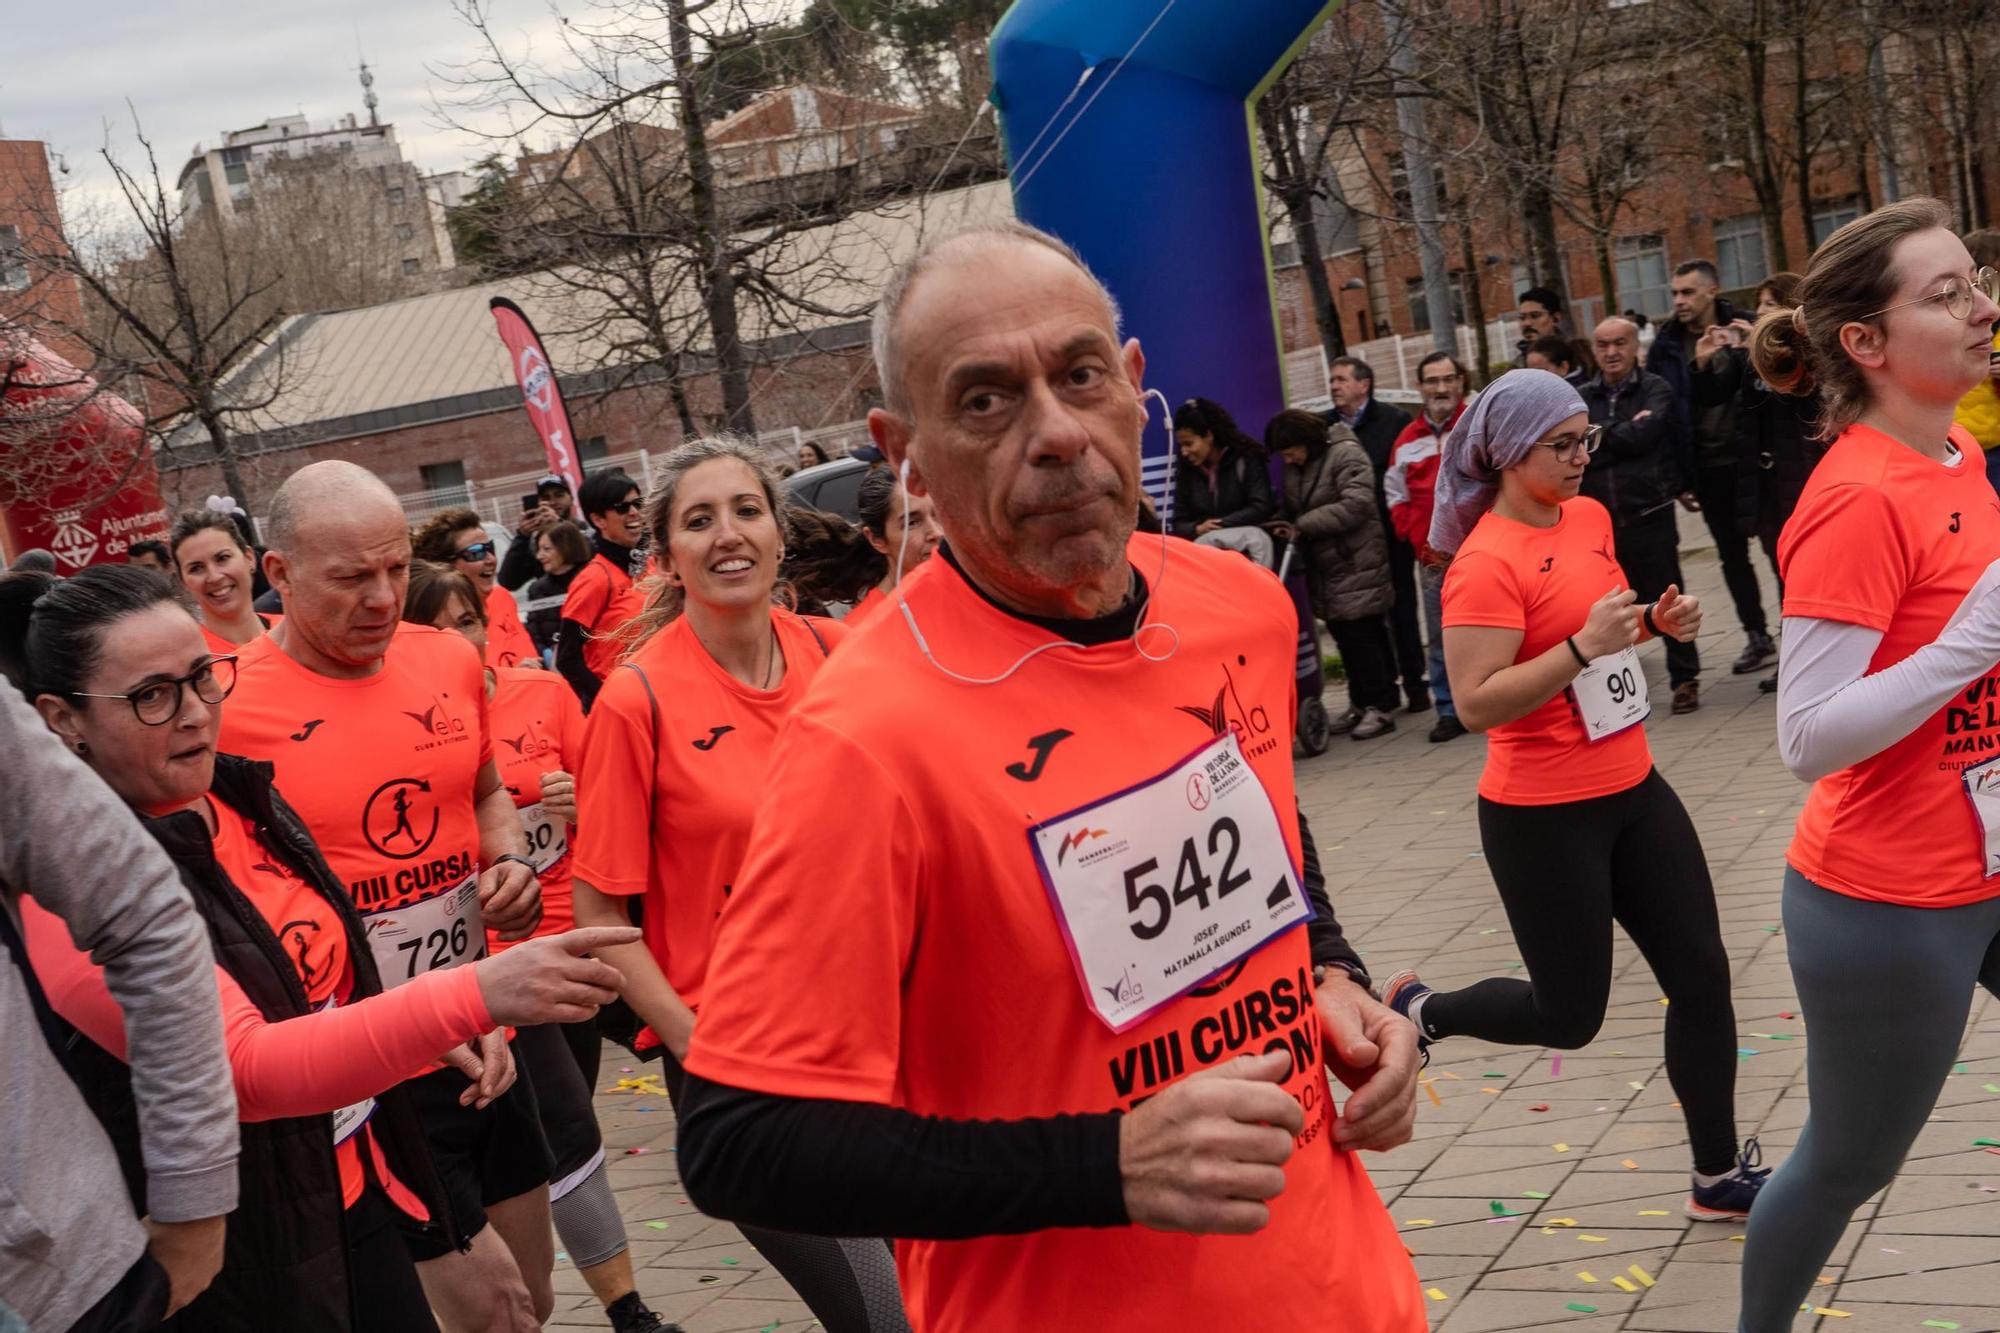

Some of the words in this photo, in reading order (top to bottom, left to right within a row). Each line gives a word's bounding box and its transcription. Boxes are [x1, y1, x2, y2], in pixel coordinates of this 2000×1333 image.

[105, 538, 128, 555] de
[1607, 667, 1636, 704] 90
[1985, 701, 2000, 728] L
[1208, 772, 1220, 786] DE
[1218, 767, 1229, 780] LA
[1226, 758, 1241, 775] DONA
[1213, 749, 1231, 768] CURSA
[395, 851, 472, 895] CURSA
[1123, 816, 1252, 940] 542
[398, 917, 468, 979] 726
[1163, 943, 1213, 979] MATAMALA
[1213, 919, 1253, 950] AGUNDEZ
[1193, 923, 1220, 946] JOSEP
[1108, 1029, 1185, 1099] VIII
[1191, 966, 1314, 1065] CURSA
